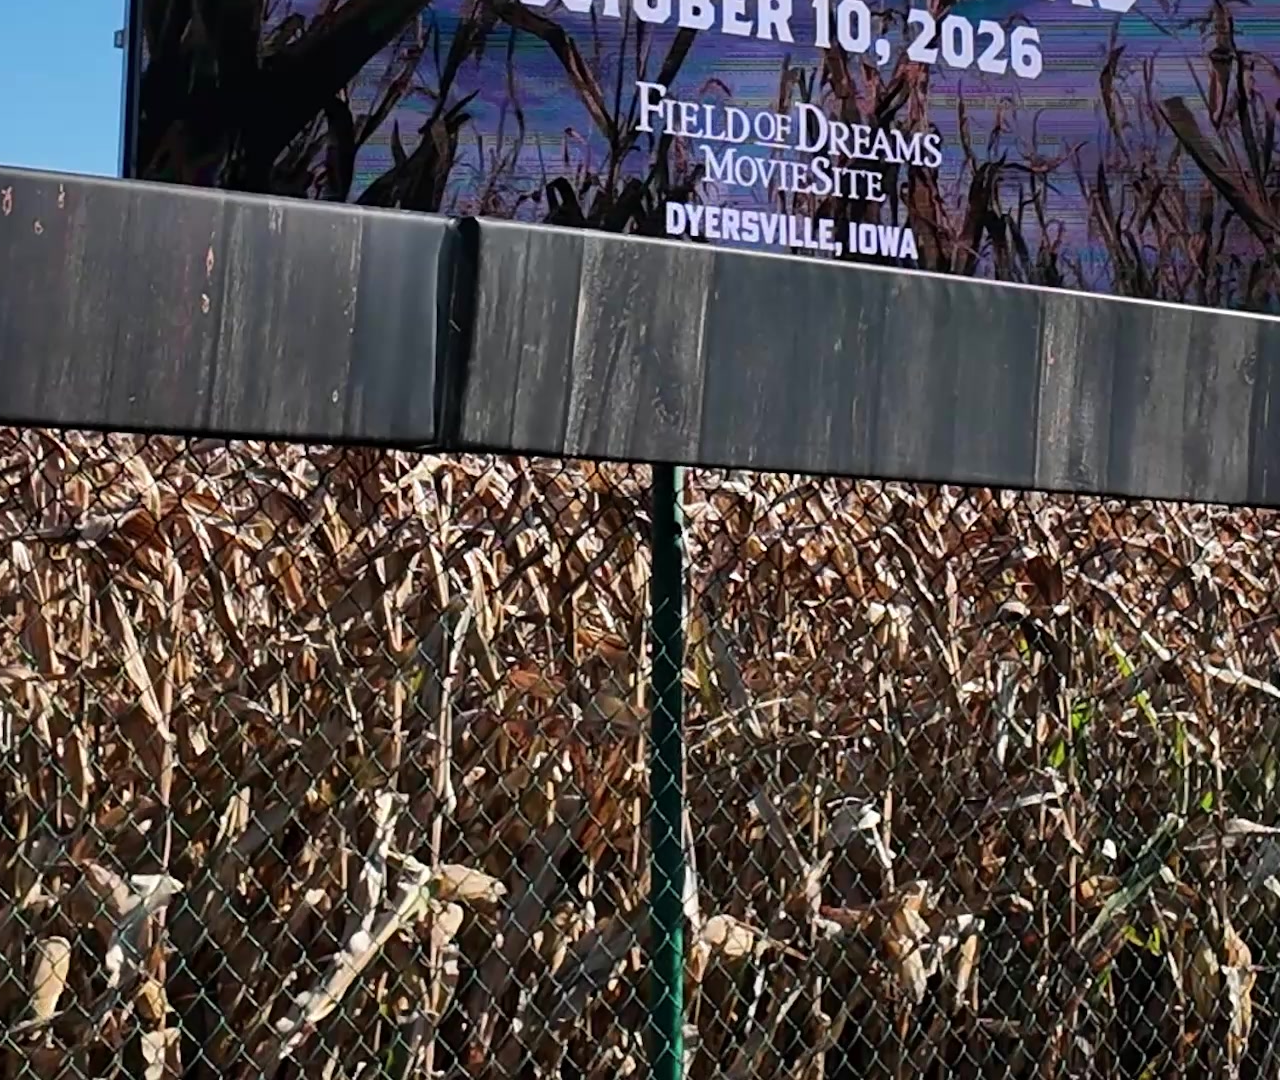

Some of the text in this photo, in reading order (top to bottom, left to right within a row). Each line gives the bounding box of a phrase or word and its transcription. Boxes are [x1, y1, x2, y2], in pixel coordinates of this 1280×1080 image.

[906, 10, 1044, 80] 2026
[635, 81, 750, 143] FIELD
[795, 102, 943, 168] DREAMS
[666, 202, 919, 260] DYERSVILLE, IOWA
